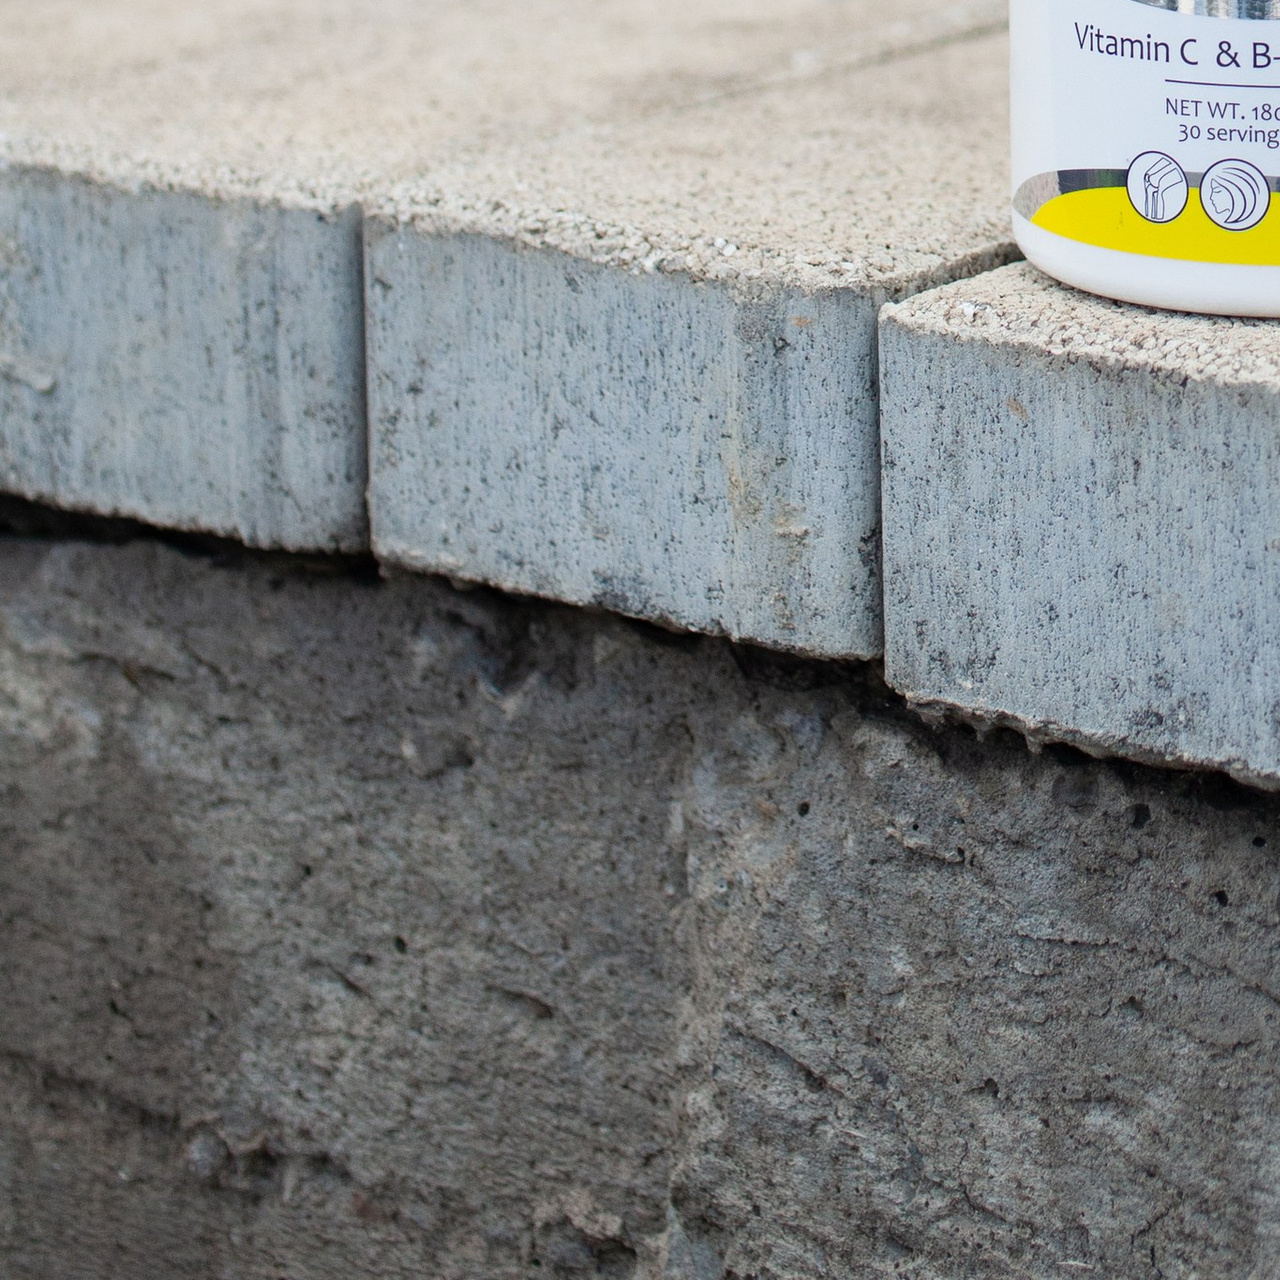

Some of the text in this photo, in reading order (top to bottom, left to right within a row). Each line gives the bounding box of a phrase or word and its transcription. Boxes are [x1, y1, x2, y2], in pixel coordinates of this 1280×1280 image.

[1074, 21, 1170, 63] Vitamin
[1179, 38, 1199, 66] C
[1215, 40, 1242, 69] &
[1165, 97, 1203, 118] NET
[1206, 100, 1246, 121] WT.
[1178, 123, 1201, 143] 30
